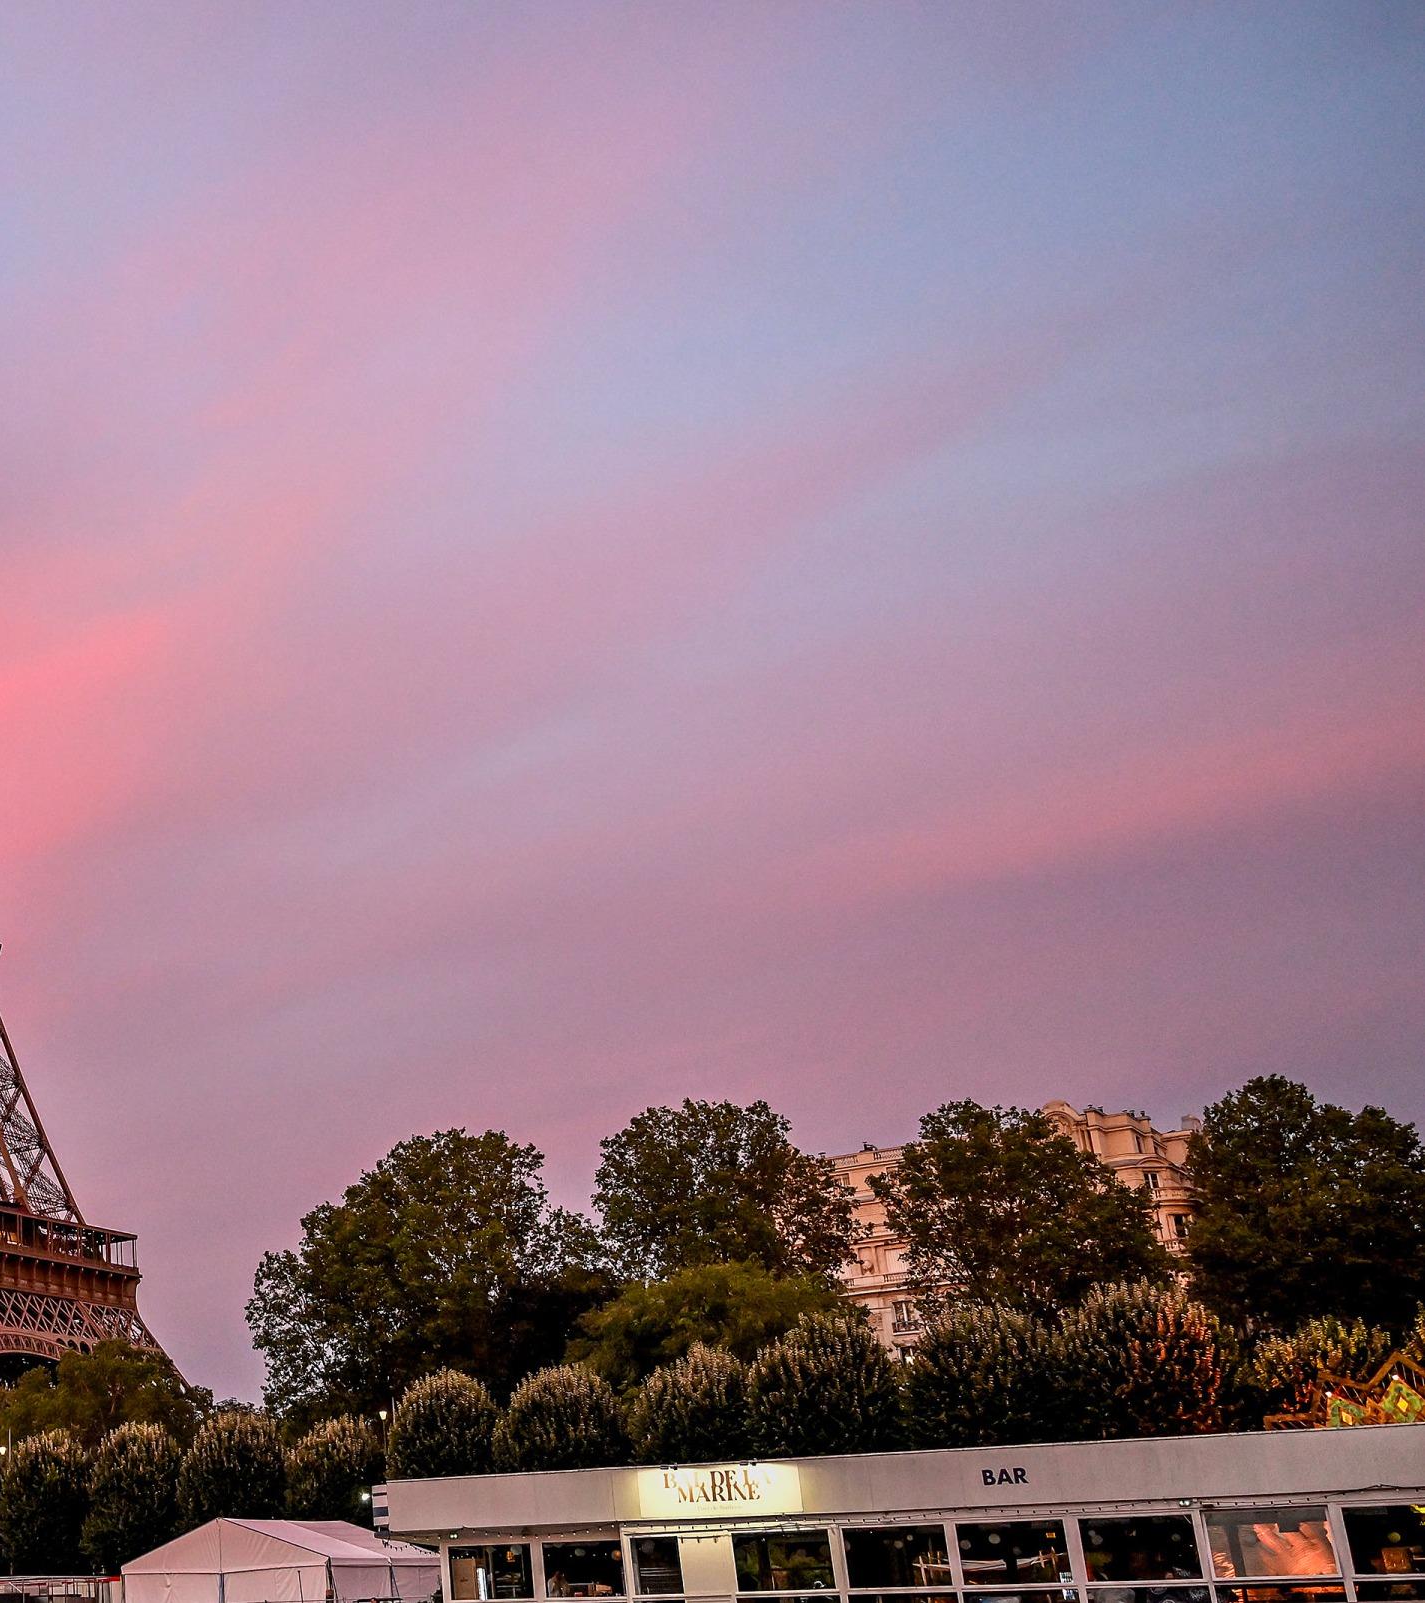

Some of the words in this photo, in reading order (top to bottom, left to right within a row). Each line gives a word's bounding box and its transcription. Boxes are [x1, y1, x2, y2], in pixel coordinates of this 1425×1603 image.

[663, 1471, 703, 1489] BL
[709, 1469, 736, 1486] DE
[982, 1468, 1029, 1485] BAR
[677, 1480, 760, 1503] MARINE
